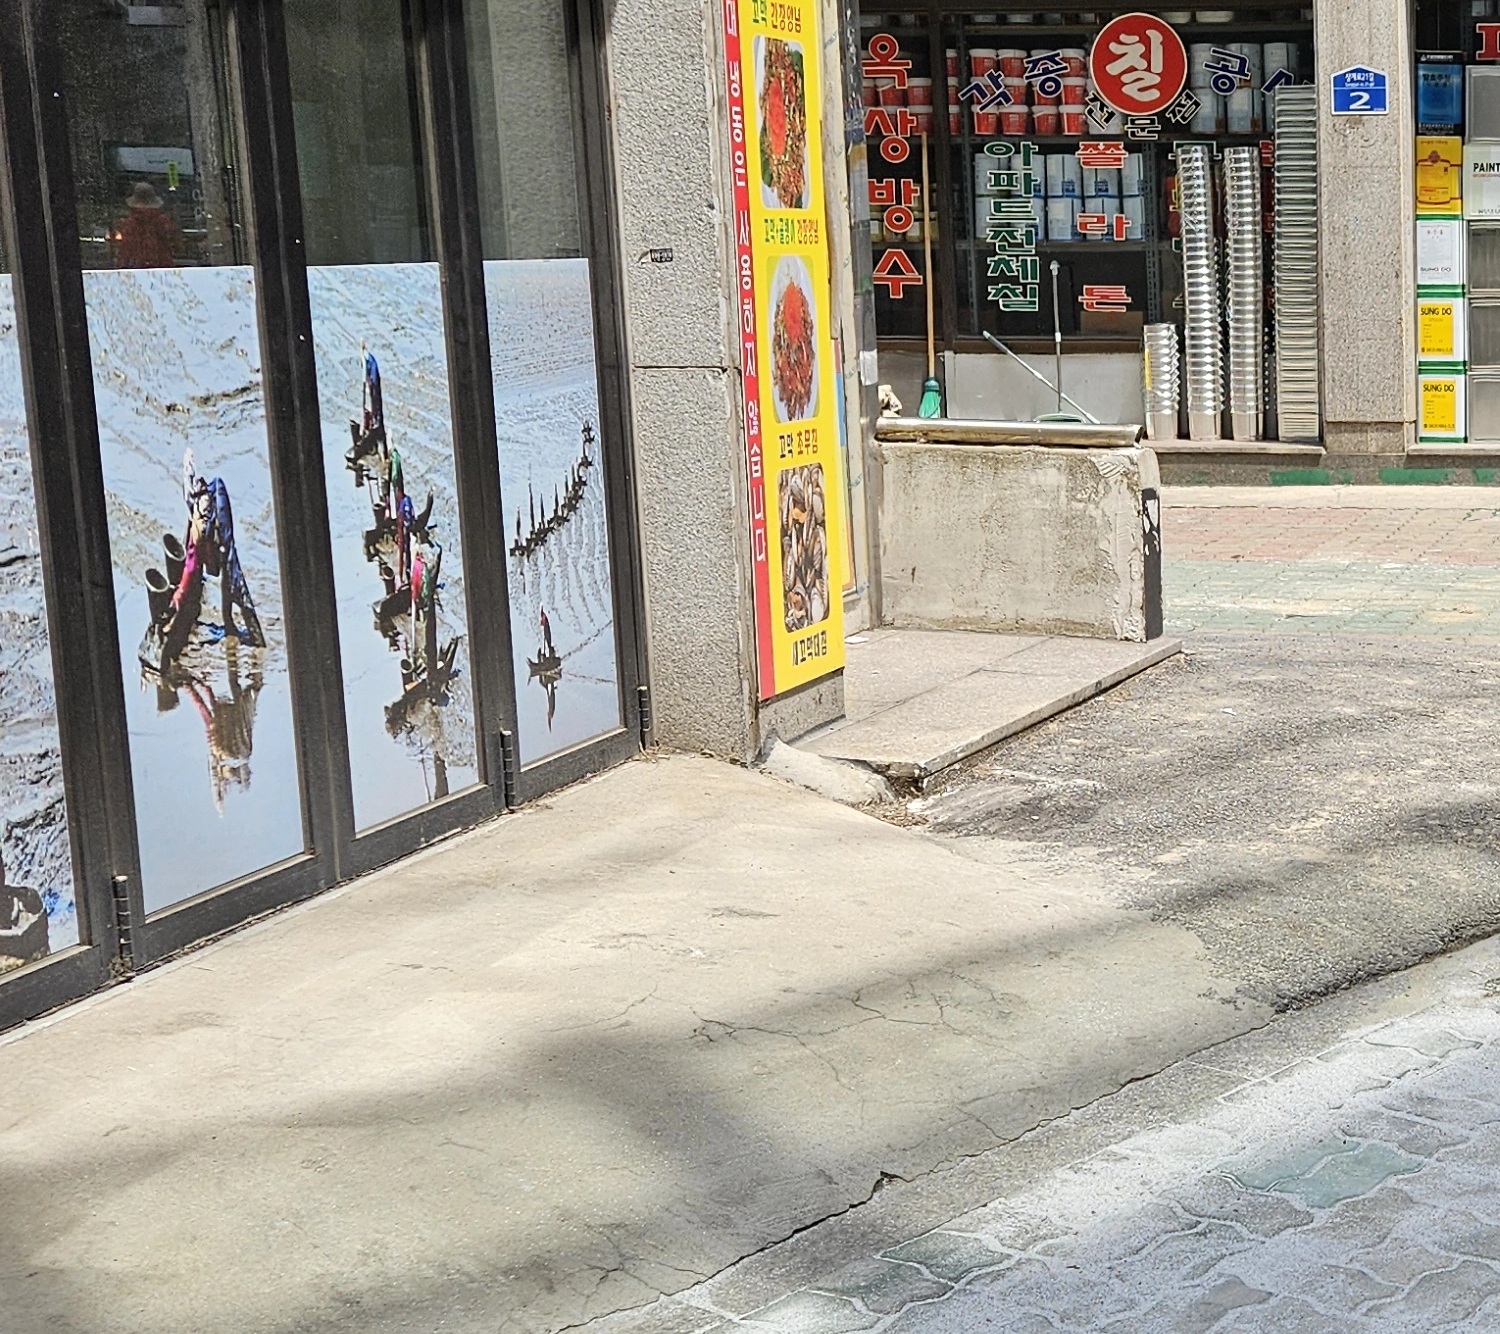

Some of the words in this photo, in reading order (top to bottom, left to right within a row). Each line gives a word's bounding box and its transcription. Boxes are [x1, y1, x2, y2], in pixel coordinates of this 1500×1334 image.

[957, 49, 1070, 114] 각종
[1105, 28, 1165, 102] 칠
[1084, 88, 1203, 142] 전문점
[1349, 91, 1371, 110] 2
[862, 32, 924, 299] 옥상방수
[1420, 307, 1440, 316] SUNG
[1441, 307, 1452, 315] DO
[1422, 383, 1442, 392] SUNG
[1443, 383, 1455, 392] DO
[747, 399, 767, 563] 않습니다
